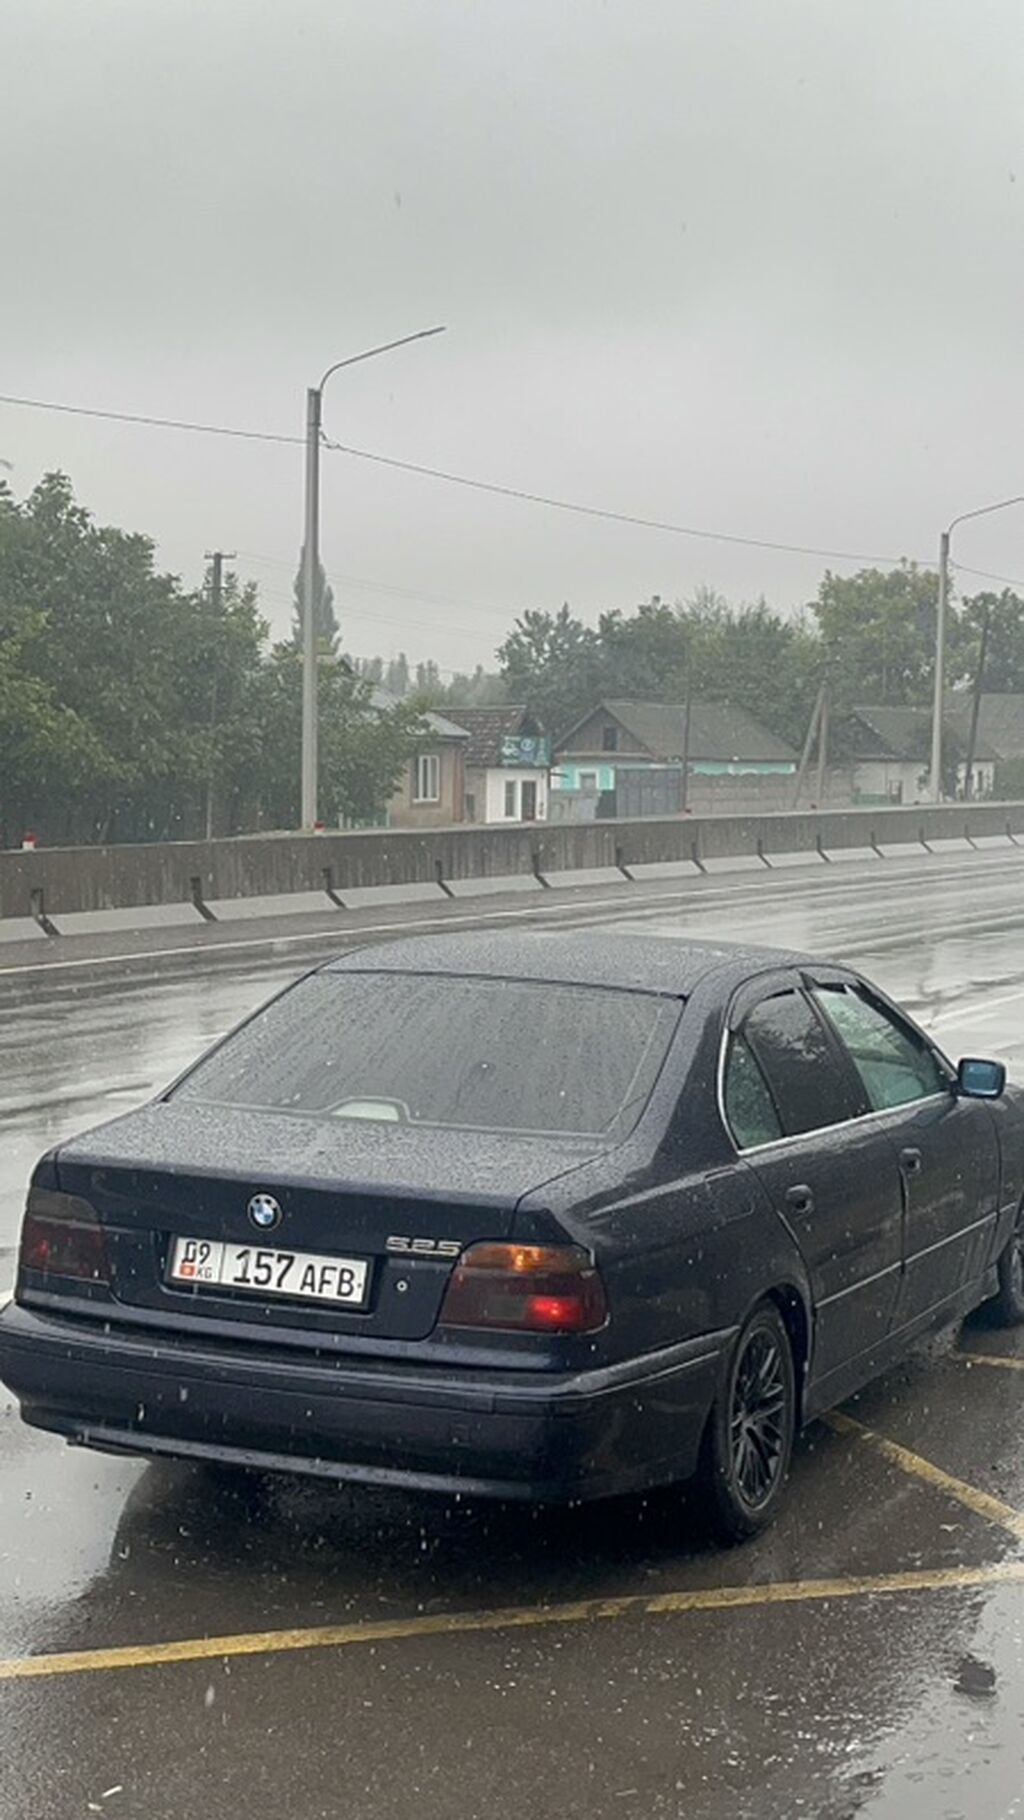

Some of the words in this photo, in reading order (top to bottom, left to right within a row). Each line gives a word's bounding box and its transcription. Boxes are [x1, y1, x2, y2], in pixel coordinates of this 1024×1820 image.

[386, 1236, 462, 1256] 525
[196, 1266, 213, 1279] KG
[233, 1249, 295, 1288] 157
[299, 1263, 355, 1297] AFB
